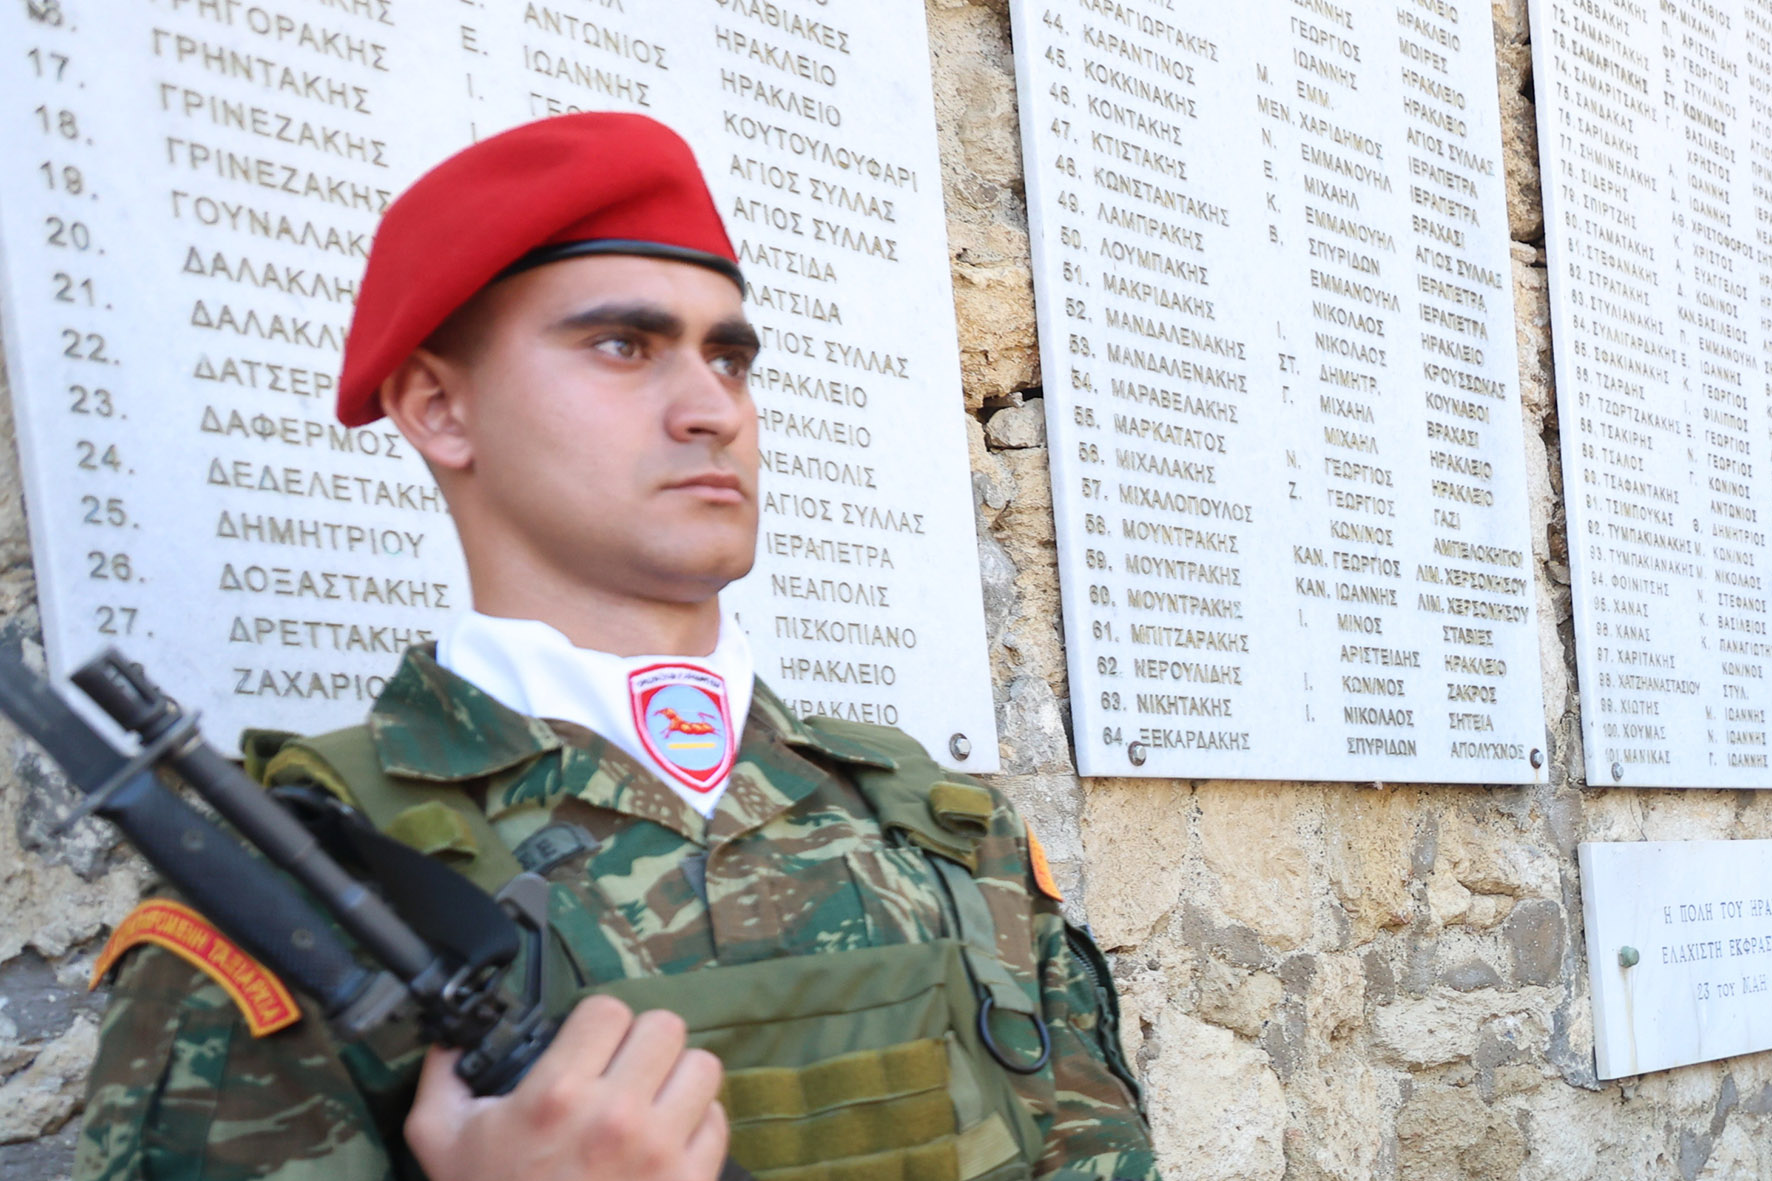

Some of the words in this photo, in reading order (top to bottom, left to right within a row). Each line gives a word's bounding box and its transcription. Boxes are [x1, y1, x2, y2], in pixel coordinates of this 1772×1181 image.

[185, 0, 389, 72] ΗΓΟΡΑΚΗΣ
[729, 153, 801, 195] ΑΓΙΟΣ
[808, 177, 896, 224] ΣΥΛΛΑΣ
[460, 24, 488, 56] Ε.
[523, 46, 651, 107] ΙΩΑΝΝΗΣ
[723, 109, 918, 193] ΚΟΥΤΟΥΛΟΥΦΑΡΙ
[523, 2, 669, 70] ΑΝΤΩΝΙΟΣ
[720, 67, 841, 128] ΗΡΑΚΛΕΙΟ
[715, 27, 838, 88] ΗΡΑΚΛΕΙΟ
[1082, 23, 1196, 87] ΚΑΡΑΝΤΙΝΟΣ
[1256, 93, 1295, 126] ΜΕΝ.
[1298, 111, 1384, 162] ΧΑΡΙΔΗΜΟΣ
[1407, 155, 1479, 200] ΙΕΡΑΠΕΤΡΑ
[27, 47, 84, 89] 17.
[158, 82, 389, 168] ΓΡΙΝΕΖΑΚΗΣ
[737, 239, 837, 284] ΛΑΤΣΙΔΑ
[152, 27, 371, 115] ΓΡΗΝΤΑΚΗΣ
[733, 196, 804, 237] ΑΓΙΟΣ
[811, 217, 899, 263] ΣΥΛΛΑΣ
[1083, 57, 1198, 120] ΚΟΚΚΙΝΑΚΗΣ
[1300, 142, 1393, 194] ΕΜΜΑΝΟΥΗΛ
[1409, 184, 1480, 228] ΙΕΡΑΠΕΤΡΑ
[34, 104, 93, 146] 18.
[165, 135, 392, 212] ΓΡΙΝΕΖΑΚΗΣ
[744, 279, 843, 326] ΛΑΤΣΙΔΑ
[1091, 129, 1188, 182] ΚΤΙΣΤΑΚΗΣ
[1304, 205, 1396, 254] ΕΜΜΑΝΟΥΗΛ
[1415, 244, 1454, 274] ΑΓΙΟΣ
[1455, 258, 1503, 290] ΣΥΛΛΑΣ
[1093, 166, 1230, 228] ΚΩΝΣΤΑΝΤΑΚΗΣ
[1307, 237, 1381, 277] ΣΠΥΡΙΔΩΝ
[1416, 273, 1488, 315] ΙΕΡΑΠΕΤΡΑ
[44, 216, 104, 255] 20.
[181, 245, 352, 303] ΔΑΛΑΚΛΗ
[749, 359, 868, 409] ΗΡΑΚΛΕΙΟ
[52, 271, 112, 310] 21.
[190, 299, 339, 352] ΔΑΛΑΚΛ
[170, 189, 367, 258] ΓΟΥΝΑΛΑΚ
[759, 325, 816, 359] ΓΙΟΣ
[823, 340, 910, 380] ΣΥΛΛΑΣ
[1099, 236, 1209, 286] ΛΟΥΜΠΑΚΗΣ
[1311, 299, 1385, 339] ΝΙΚΟΛΑΟΣ
[1420, 332, 1485, 368] ΗΡΑΚΛΕΙΟ
[60, 328, 120, 365] 22.
[192, 354, 333, 402] ΔΑΤΣΕΡ
[758, 449, 877, 490] ΝΕΑΠΟΛΙΣ
[1104, 306, 1246, 361] ΜΑΝΔΑΛΕΝΑΚΗΣ
[1318, 363, 1381, 396] ΔΗΜΗΤΡ.
[1424, 390, 1490, 425] ΚΟΥΝΑΒΟΙ
[68, 384, 126, 420] 23.
[199, 405, 402, 460] ΔΑΦΕΡΜΟΣ
[763, 490, 833, 522] ΑΓΙΟΣ
[841, 502, 925, 535] ΣΥΛΛΑΣ
[75, 439, 134, 475] 24.
[206, 456, 448, 513] ΔΕΔΕΛΕΤΑΚΗ
[766, 531, 895, 570] ΙΕΡΑΠΕΤΡΑ
[1115, 447, 1216, 485] ΜΙΧΑΛΑΚΗΣ
[1326, 487, 1396, 518] ΓΕΩΡΓΙΟΣ
[80, 494, 139, 530] 25.
[215, 510, 424, 559] ΔΗΜΗΤΡΙΟΥ
[770, 573, 890, 608] ΝΕΑΠΟΛΙΣ
[87, 550, 145, 583] 26.
[218, 562, 451, 609] ΔΟΞΑΣΤΑΚΗΣ
[774, 615, 917, 649] ΠΙΣΚΟΠΙΑΝΟ
[1125, 552, 1242, 588] ΜΟΥΝΤΡΑΚΗΣ
[1295, 576, 1331, 600] ΚΑΝ.
[1335, 582, 1398, 608] ΙΩΑΝΝΗΣ
[94, 604, 154, 638] 27.
[779, 656, 896, 686] ΗΡΑΚΛΕΙΟ
[233, 667, 385, 704] ΖΑΧΑΡΙΟ
[1135, 693, 1233, 718] ΝΙΚΗΤΑΚΗΣ
[1343, 705, 1415, 728] ΝΙΚΟΛΑΟΣ
[1448, 712, 1494, 733] ΣΗΤΕΙΑ
[1138, 727, 1251, 754] ΞΕΚΑΡΔΑΚΗΣ
[1346, 736, 1417, 757] ΣΠΥΡΙΔΩΝ
[1662, 941, 1722, 964] ΕΛΑΧΙΣΤΗ
[1664, 906, 1672, 924] Η
[1680, 903, 1713, 923] ΠΟΛΗ
[1720, 901, 1743, 919] ΤΟΥ
[1698, 982, 1710, 1000] 23
